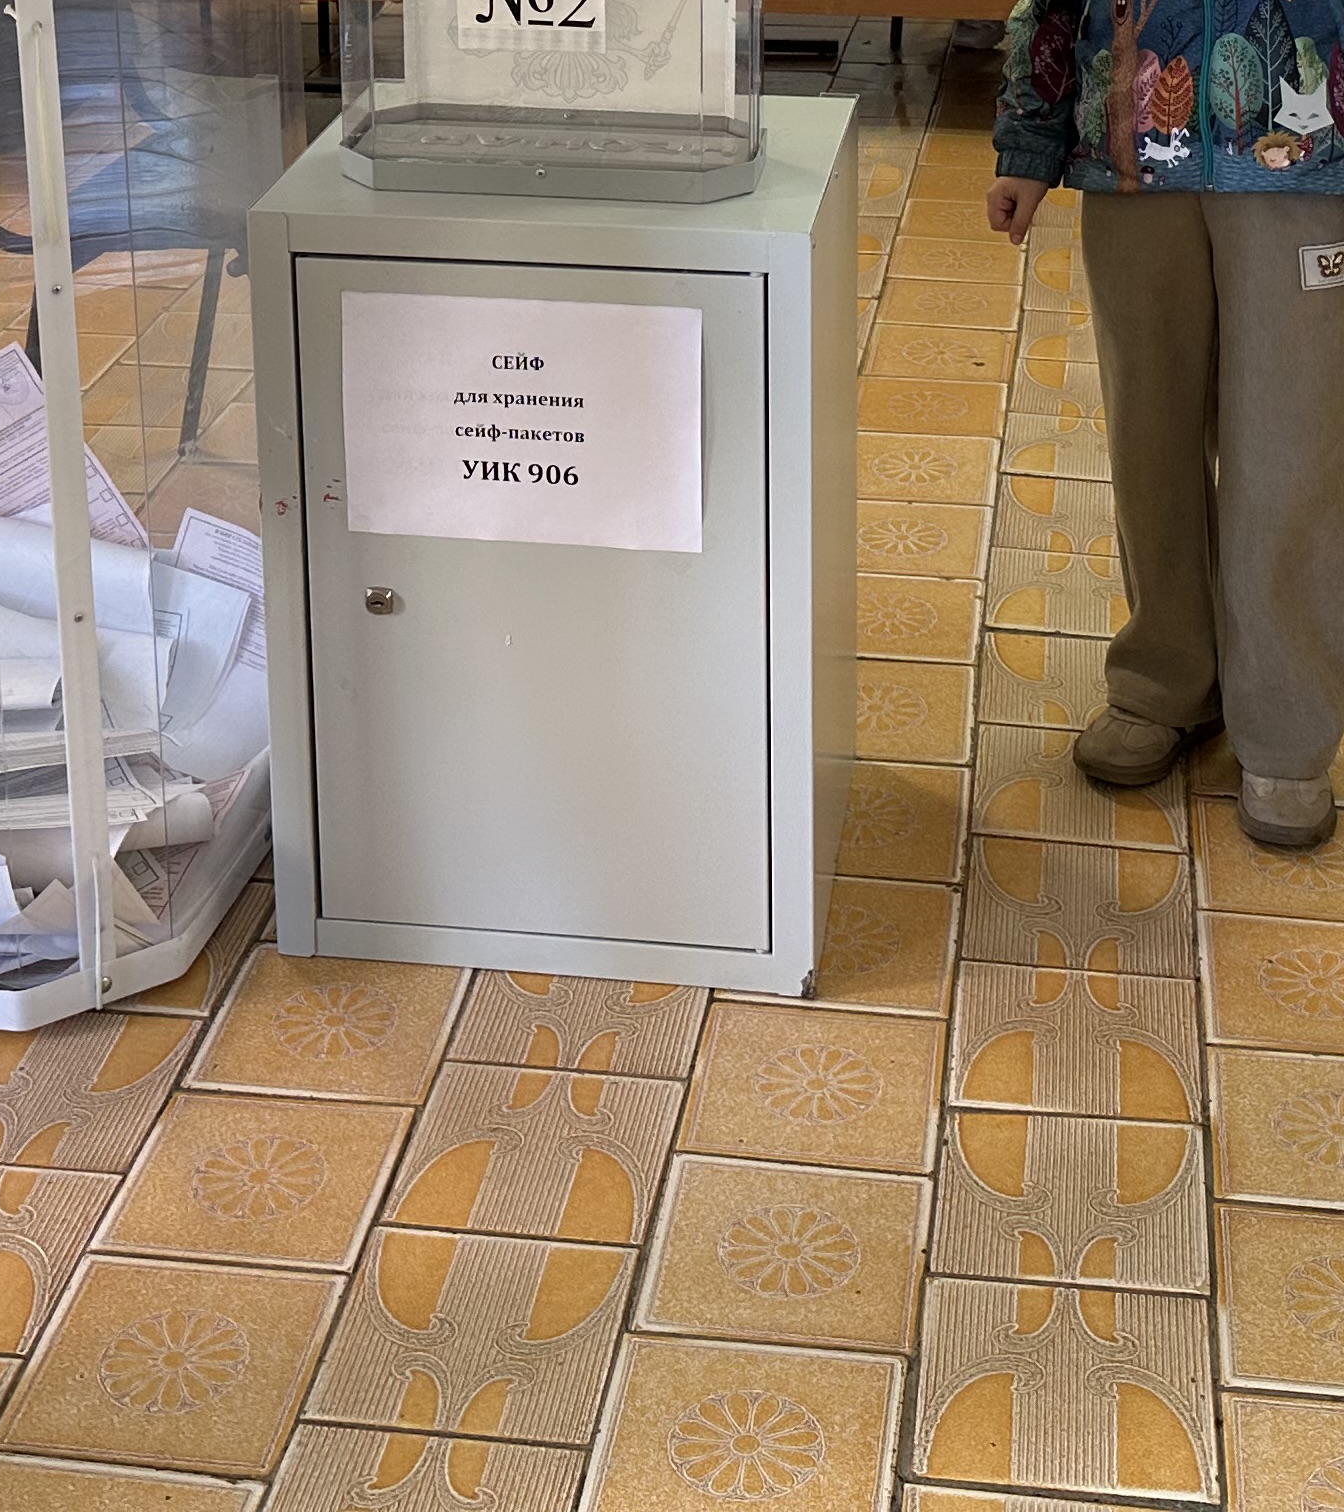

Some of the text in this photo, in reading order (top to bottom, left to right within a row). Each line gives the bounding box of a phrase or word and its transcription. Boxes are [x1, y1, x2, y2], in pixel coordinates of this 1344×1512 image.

[491, 352, 545, 371] СЕЙФ
[453, 391, 584, 409] для хранения
[454, 423, 586, 443] сейф-пакетов
[462, 459, 580, 486] УИК 906
